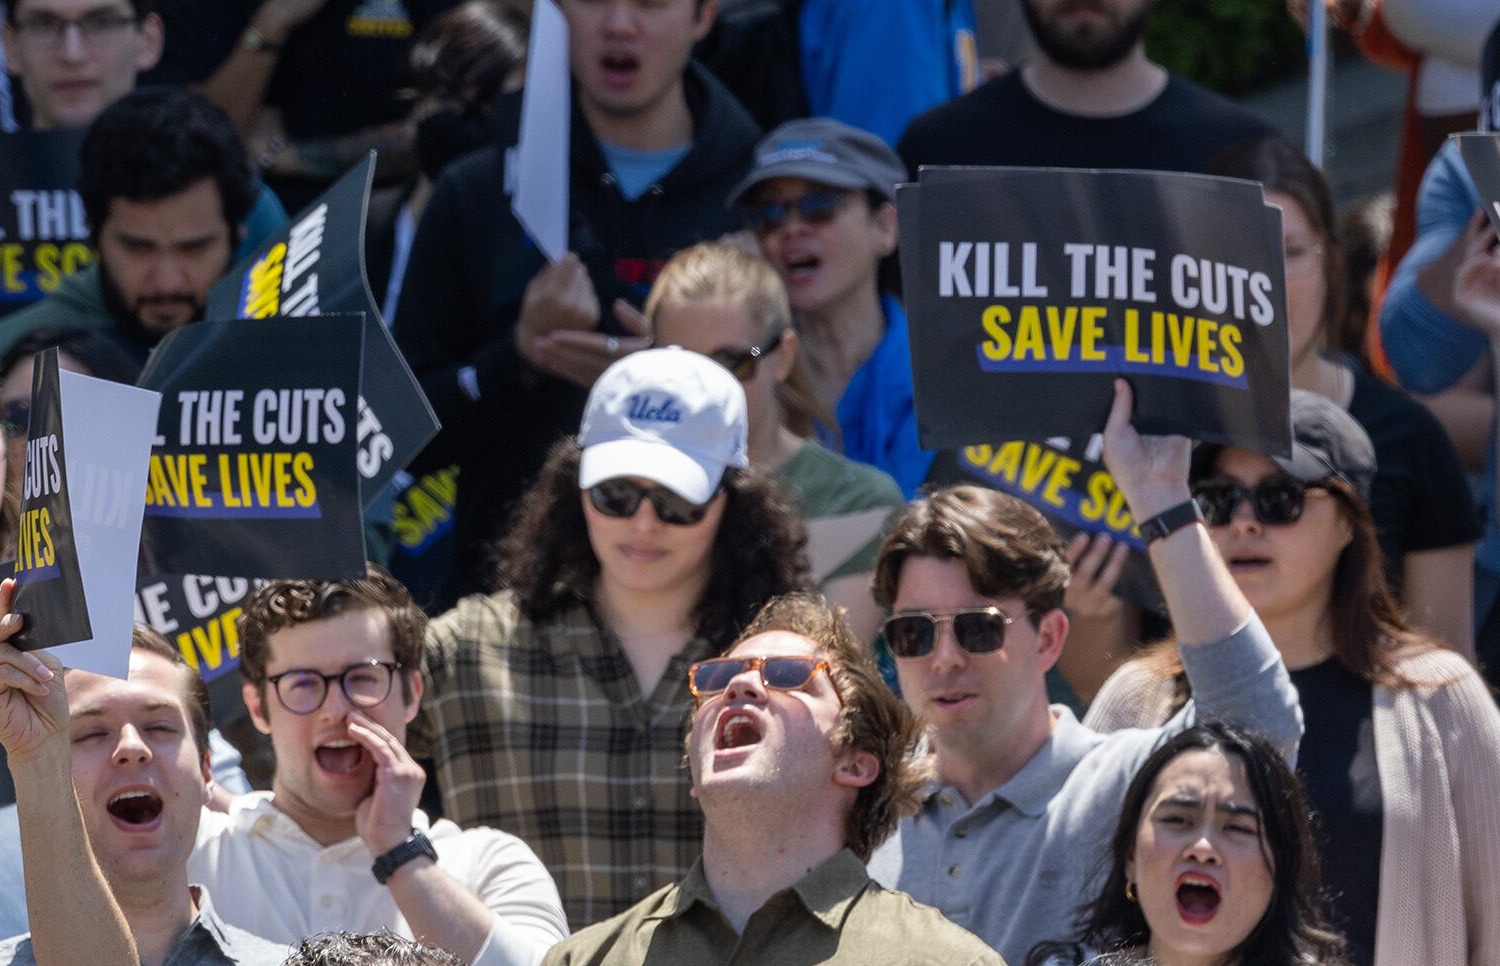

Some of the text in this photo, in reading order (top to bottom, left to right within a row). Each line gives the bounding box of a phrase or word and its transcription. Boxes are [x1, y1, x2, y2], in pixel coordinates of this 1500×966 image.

[938, 241, 1275, 327] KILL THE CUTS
[981, 304, 1246, 379] SAVE LIVES
[178, 388, 244, 446] THE
[253, 387, 347, 446] CUTS
[218, 451, 318, 509] LIVES
